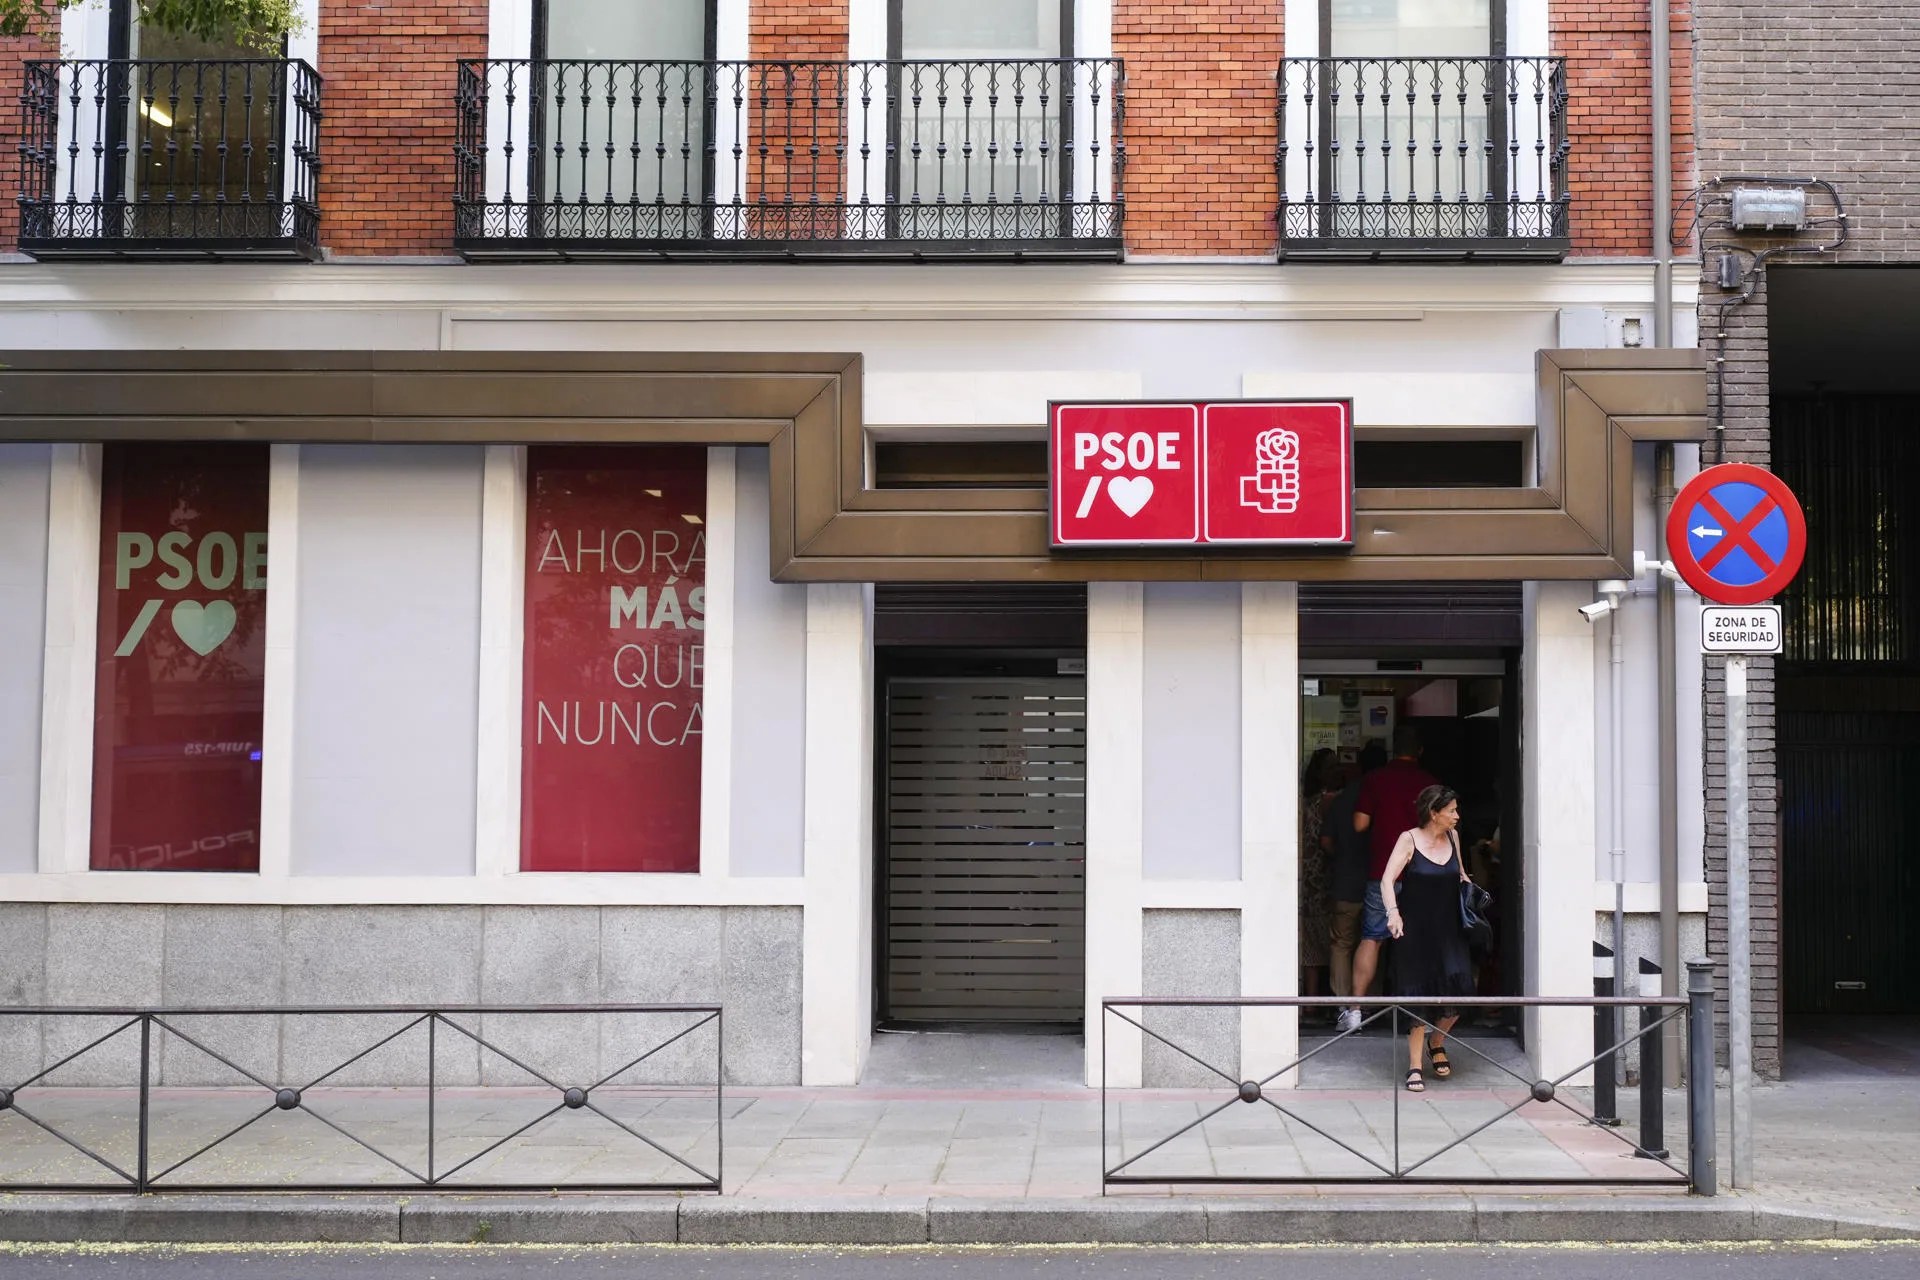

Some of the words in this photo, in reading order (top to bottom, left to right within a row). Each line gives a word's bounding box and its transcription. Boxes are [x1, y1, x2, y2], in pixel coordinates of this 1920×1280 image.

[1074, 431, 1181, 470] PSOE
[115, 531, 268, 591] PSOE
[537, 528, 706, 574] AHORA
[1708, 631, 1774, 642] SEGURIDAD
[1715, 617, 1747, 628] ZONA
[1751, 617, 1766, 628] DE
[613, 643, 704, 689] QUE
[537, 701, 704, 746] NUNCA
